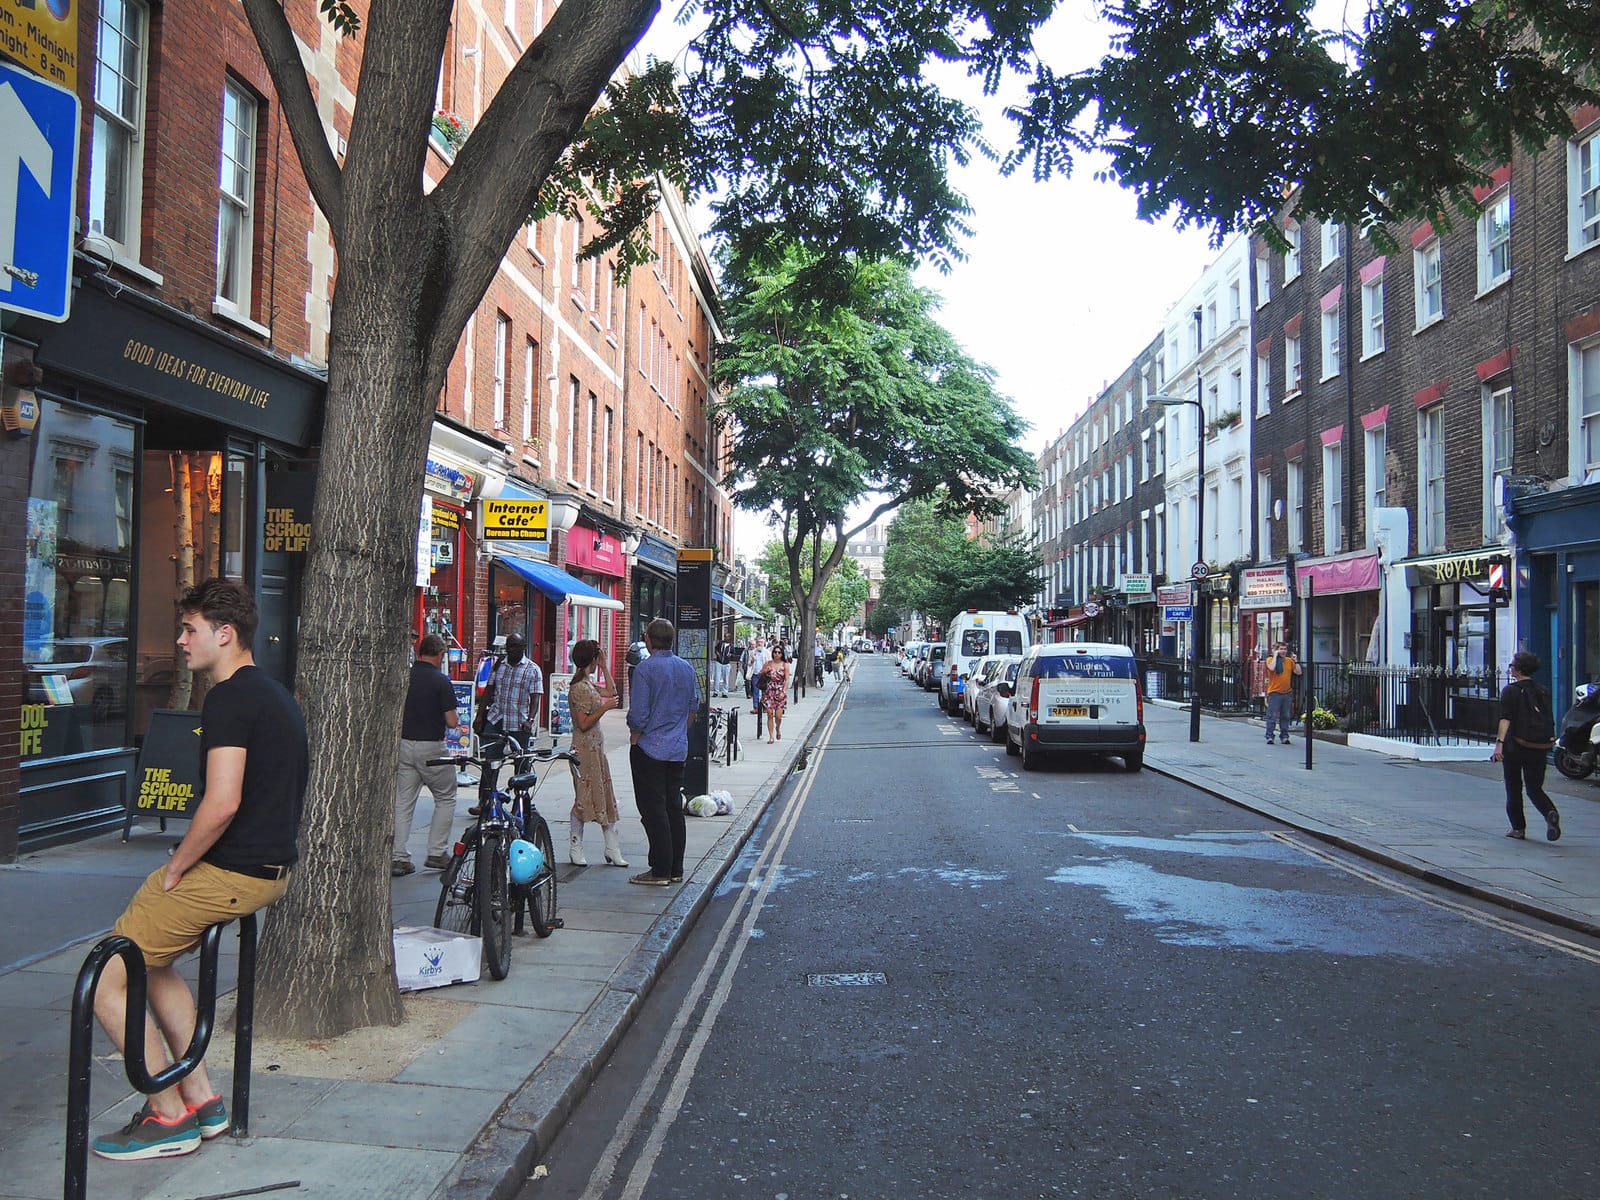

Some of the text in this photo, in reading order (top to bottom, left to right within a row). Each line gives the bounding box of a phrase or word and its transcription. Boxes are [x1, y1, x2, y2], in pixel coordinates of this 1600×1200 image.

[27, 22, 74, 68] Midnight
[41, 53, 48, 70] 8
[50, 63, 66, 82] am
[123, 339, 271, 409] GOOD IDEAS FOR EVERYDAY LIFE
[266, 508, 295, 523] THE
[489, 502, 544, 514] Internet
[486, 529, 510, 537] Bureau
[520, 530, 545, 539] Change
[265, 536, 284, 551] OF
[1193, 566, 1207, 575] 20
[1436, 557, 1482, 582] ROYAL
[20, 728, 43, 756] IFE
[144, 767, 172, 782] THE
[140, 781, 195, 798] SCHOOL
[137, 794, 188, 811] OF LIFE
[419, 965, 443, 976] Kirbys
